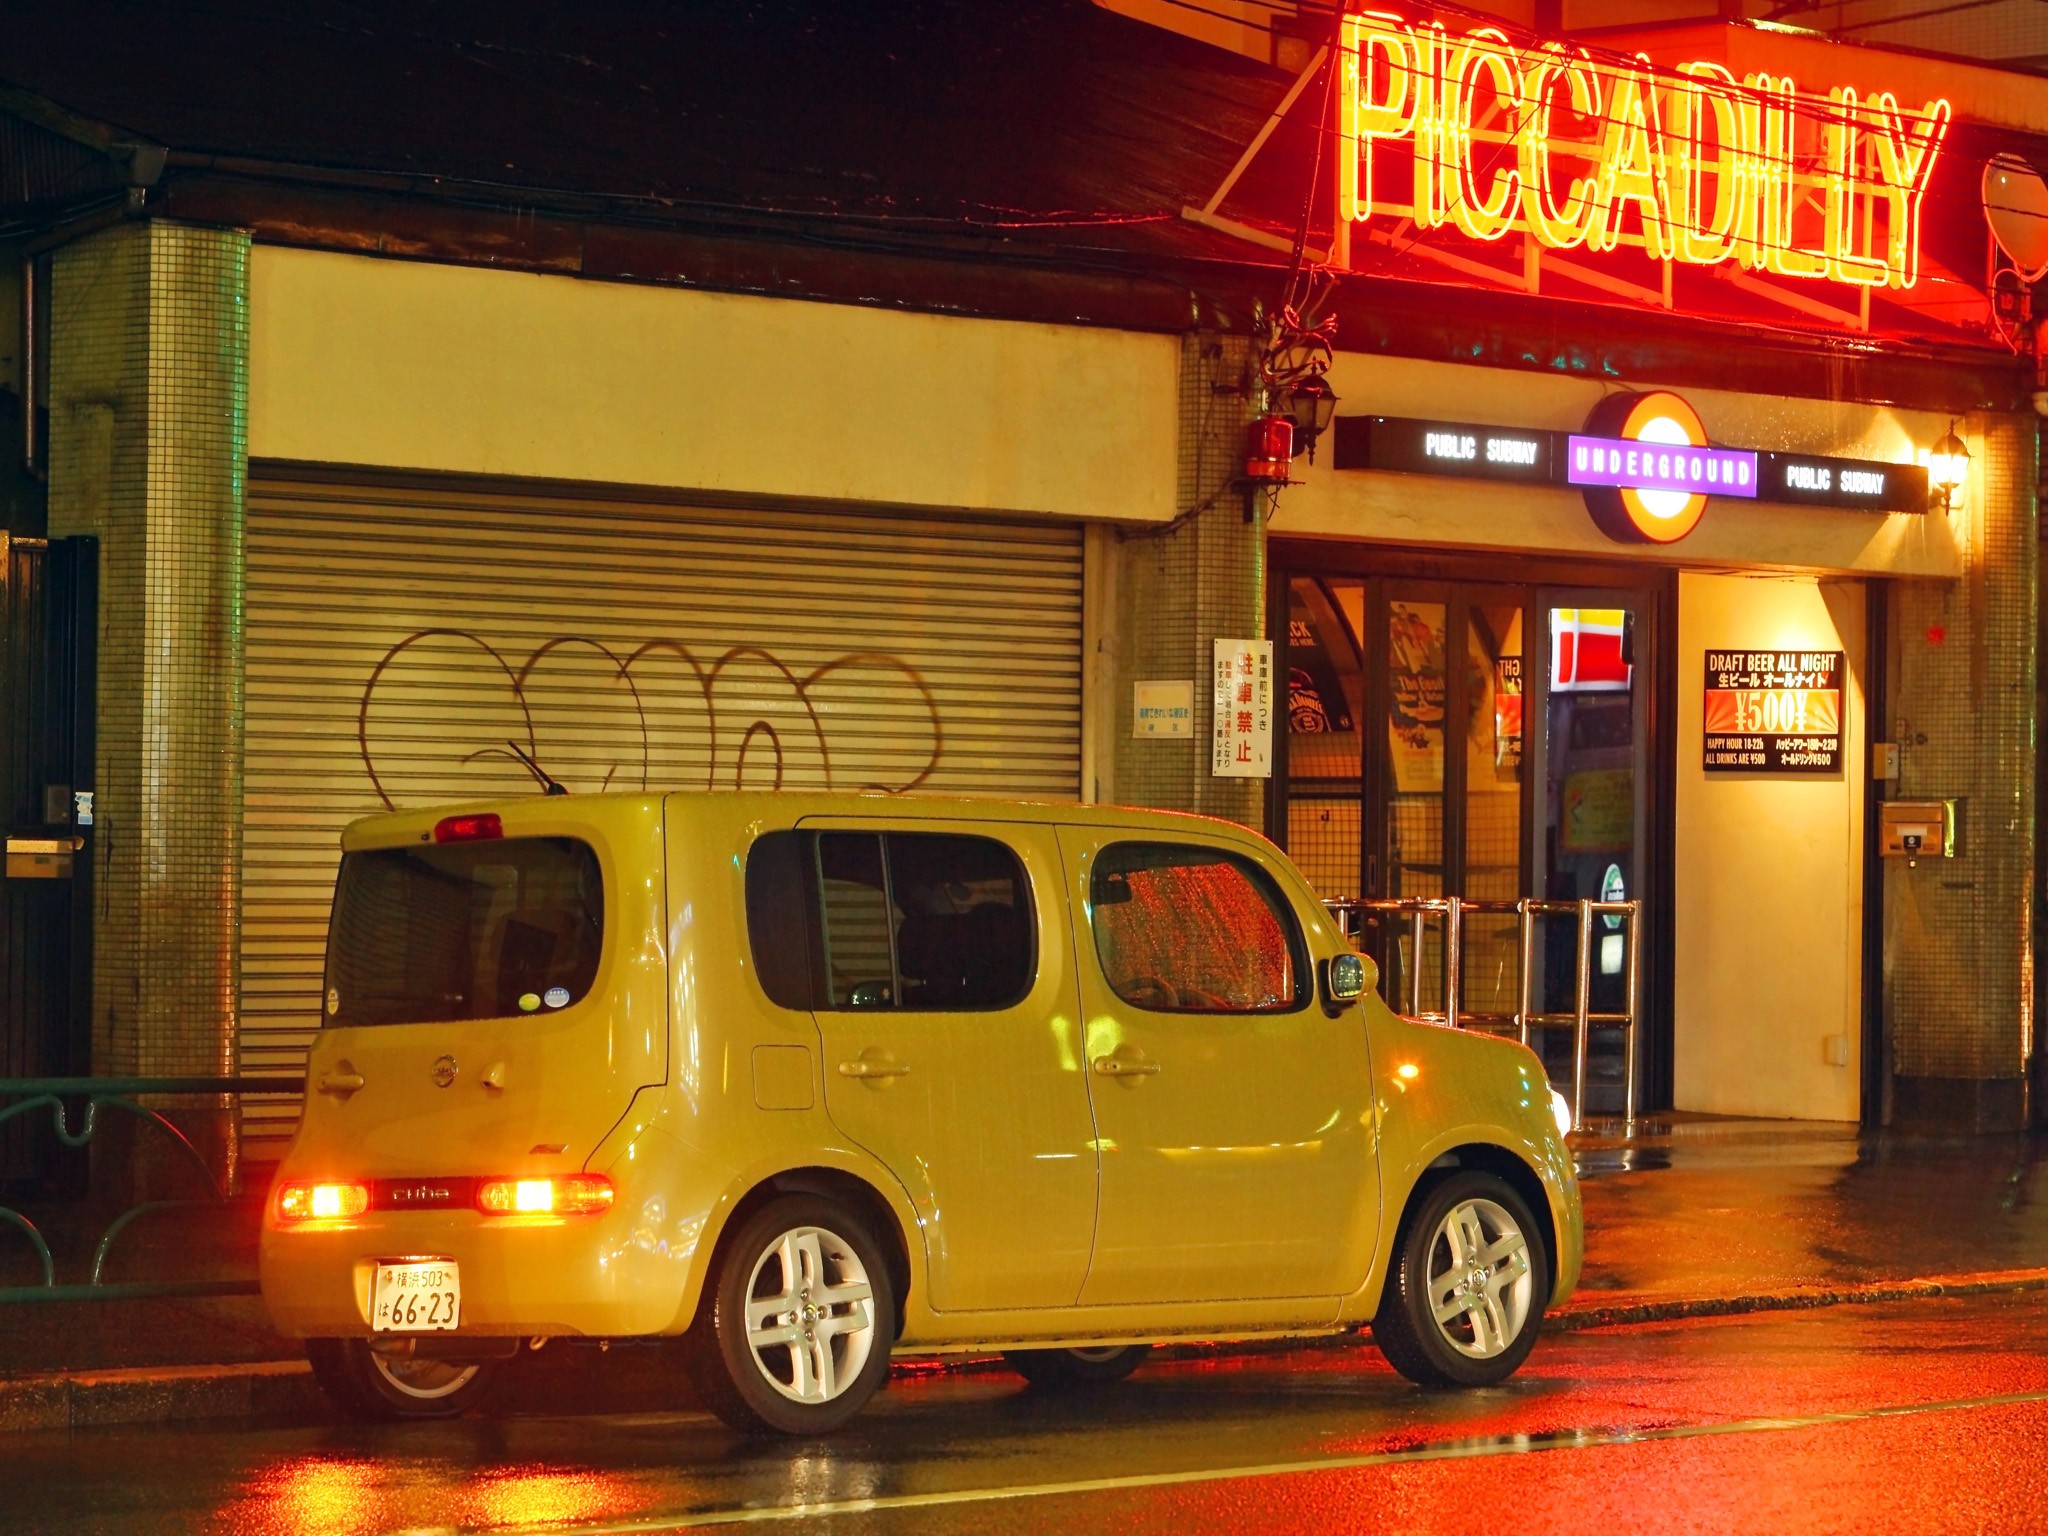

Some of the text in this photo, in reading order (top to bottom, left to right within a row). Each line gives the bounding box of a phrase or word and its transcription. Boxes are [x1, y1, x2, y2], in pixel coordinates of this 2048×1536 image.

[1341, 11, 1951, 289] PICCADILLY
[1426, 433, 1538, 465] PUBLIC SUBWAY
[1576, 446, 1750, 485] UNDERGROUND
[1786, 465, 1885, 496] PUBLIC SUBWAY
[1709, 654, 1837, 672] DRAFT BEER ALL NIGHT
[1718, 672, 1826, 688] 生ビール オールナイト
[1236, 652, 1254, 763] 駐車禁止
[1735, 691, 1808, 732] ¥500¥
[1705, 753, 1766, 765] ALL DRINKS ARE ¥500
[1707, 738, 1725, 750] HAPPY
[1726, 738, 1743, 750] HOUR
